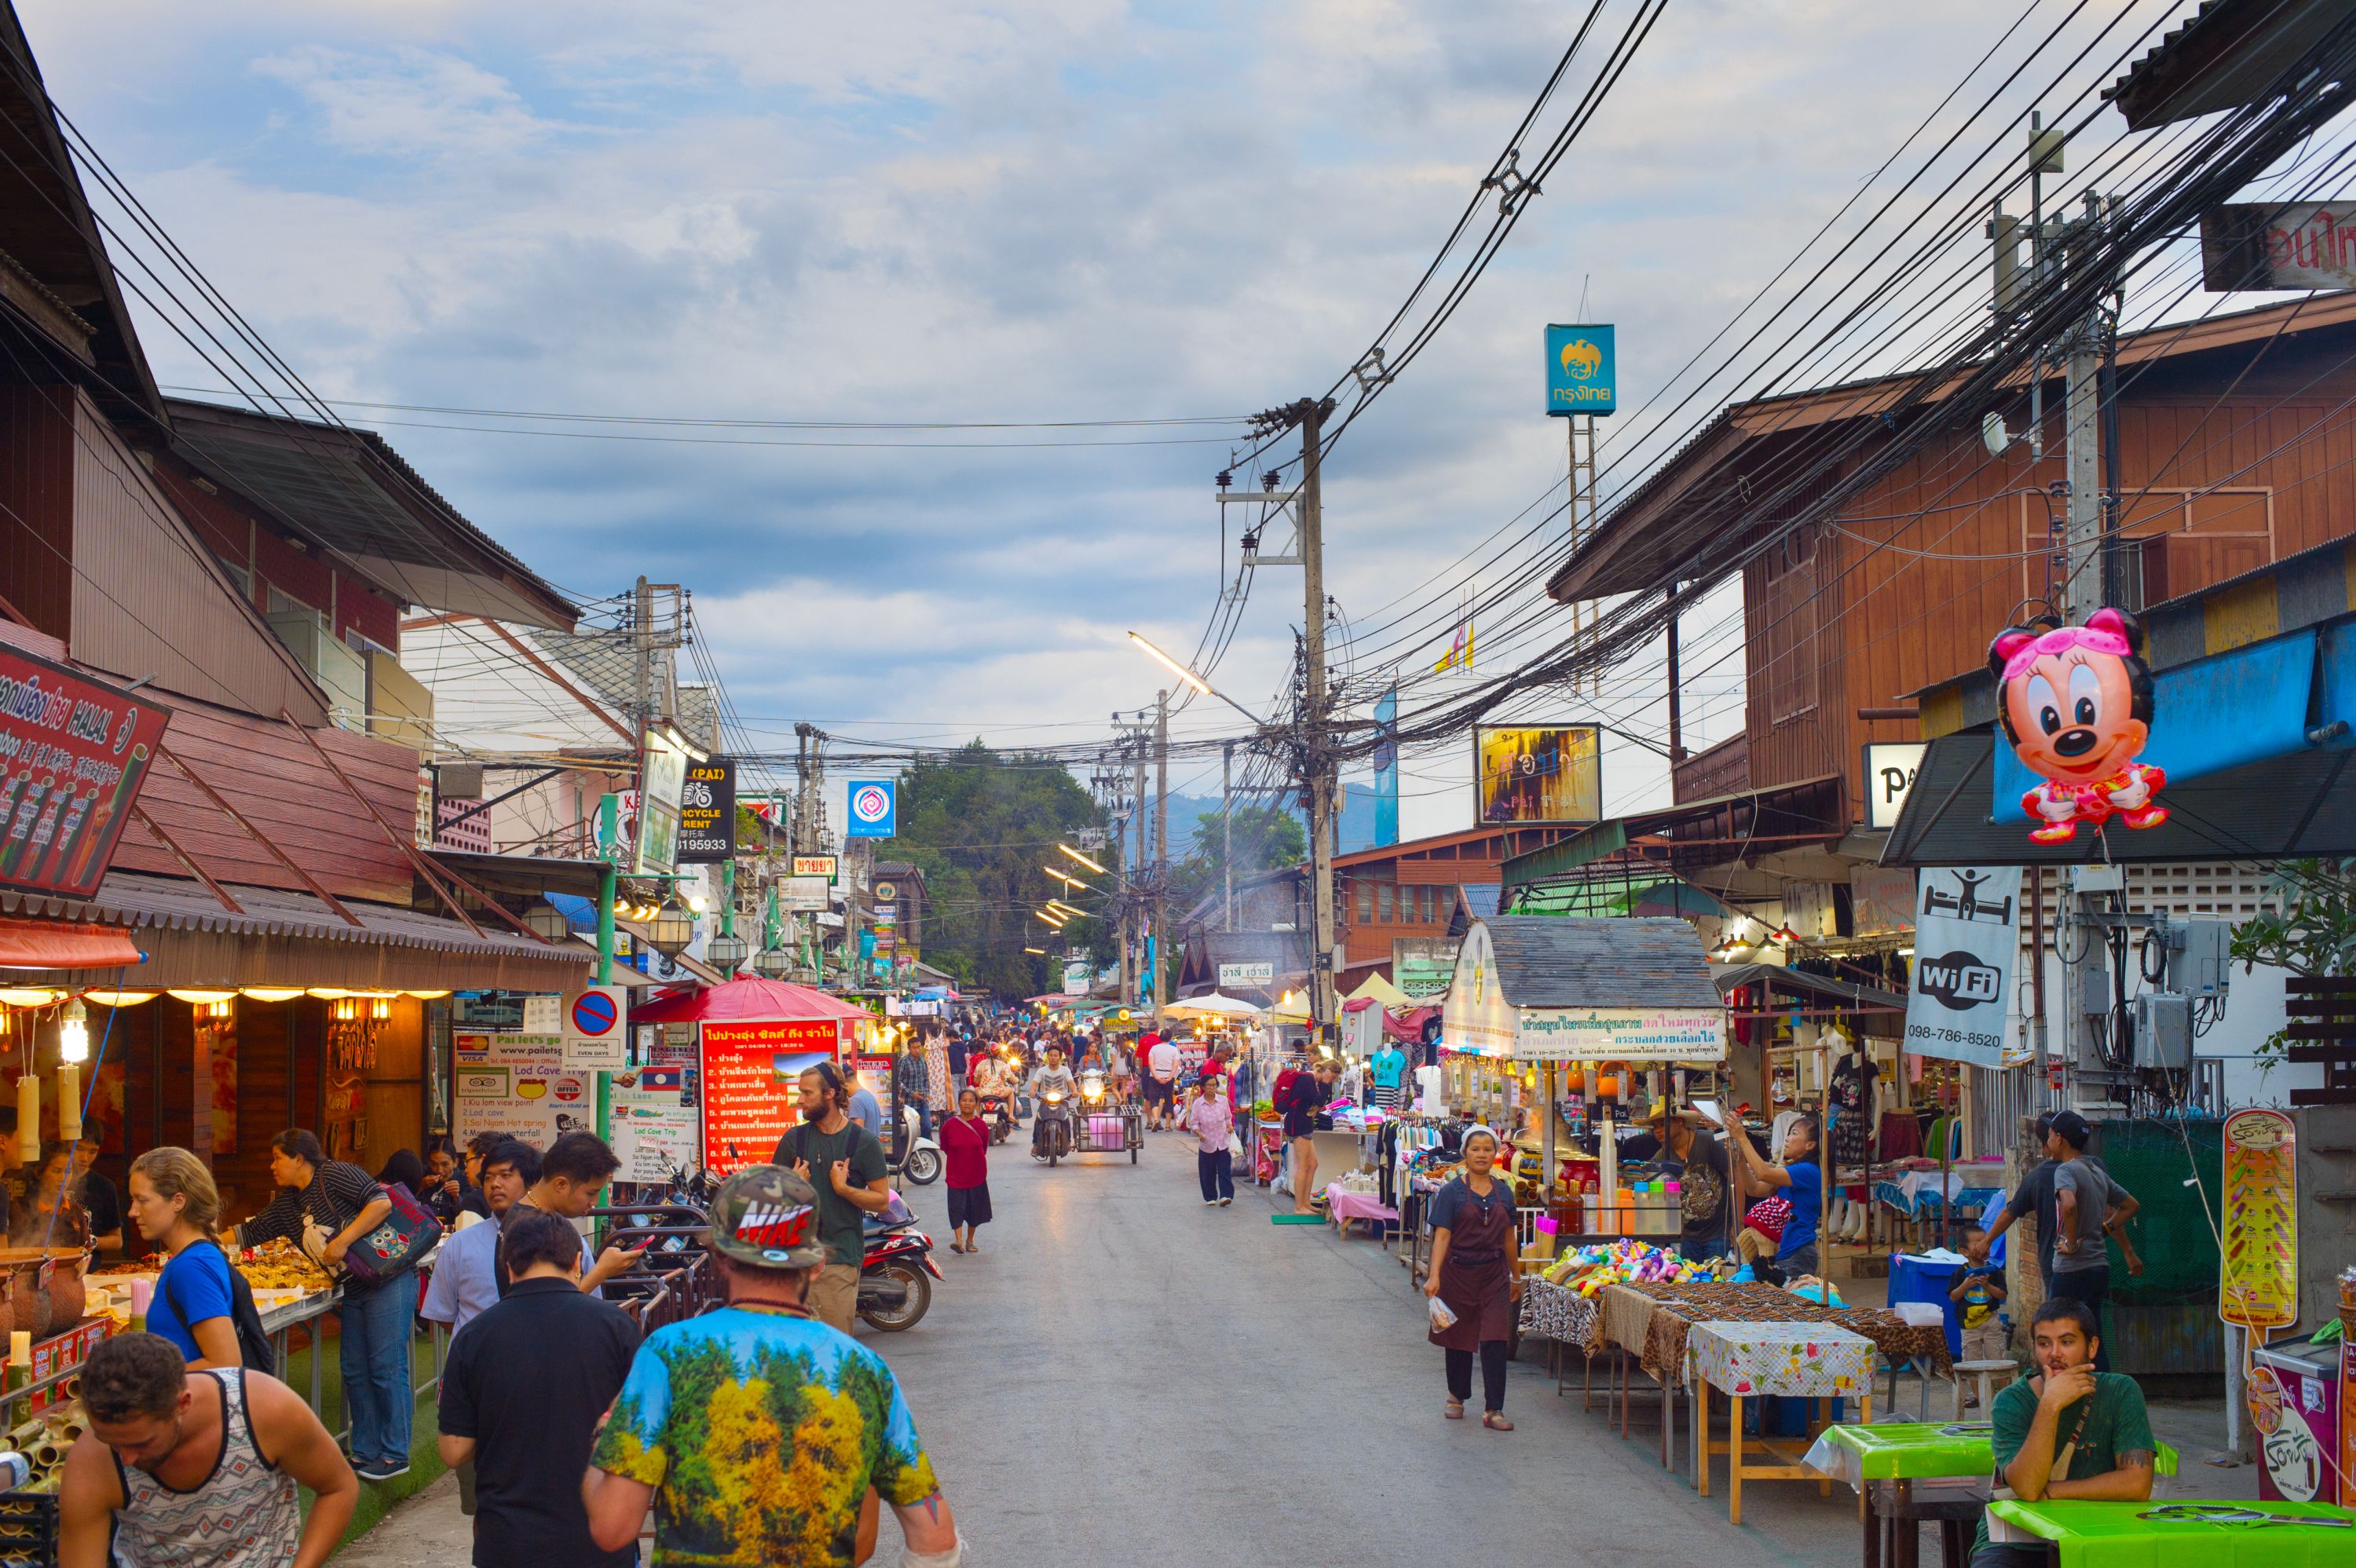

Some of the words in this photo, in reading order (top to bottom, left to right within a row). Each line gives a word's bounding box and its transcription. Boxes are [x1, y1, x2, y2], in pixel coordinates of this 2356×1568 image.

[1554, 386, 1610, 404] กรุงไทย
[67, 700, 113, 744] HALAL
[692, 769, 725, 780] (PAI)
[1511, 795, 1533, 808] Pai
[797, 860, 832, 872] ขายยา
[1615, 1030, 1714, 1044] กระบอกสวยเลือกได้
[1908, 1025, 2000, 1047] 098-786-8520
[515, 1066, 532, 1075] Lod
[537, 1066, 560, 1075] Cave
[515, 1099, 534, 1108] point
[484, 1120, 504, 1128] Ngam
[562, 1117, 580, 1128] FREE
[664, 1128, 677, 1137] Trip
[735, 1200, 814, 1246] NIKE
